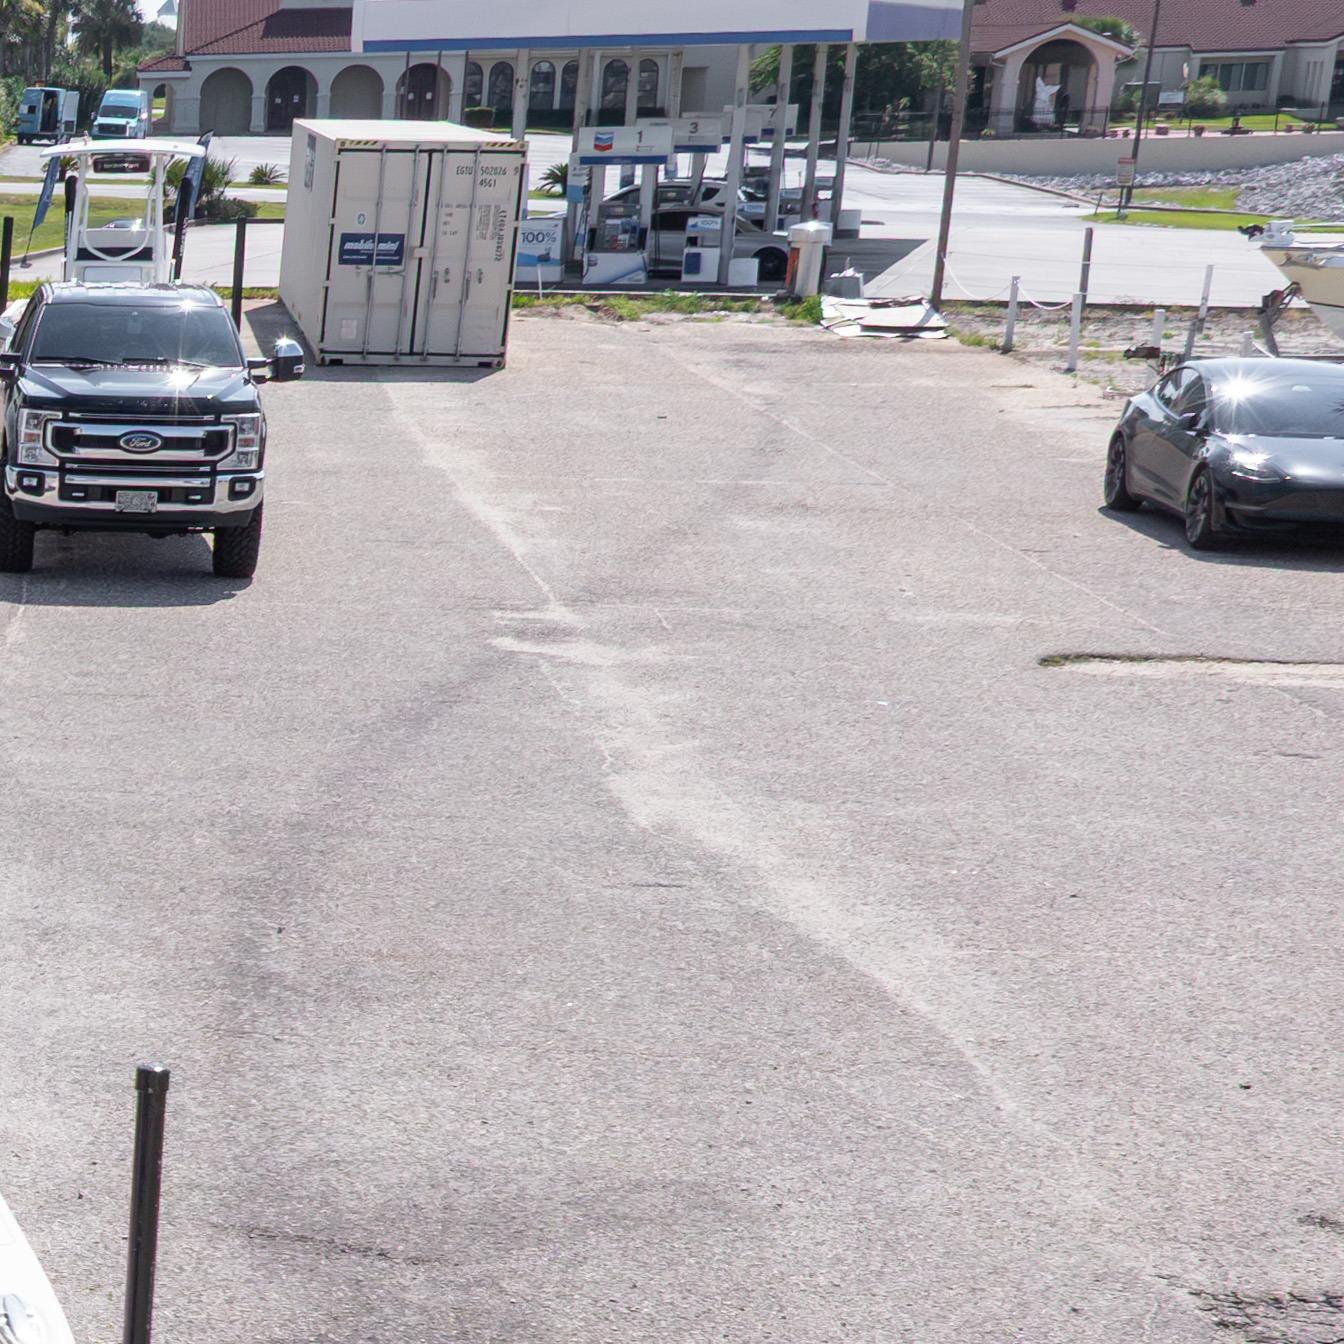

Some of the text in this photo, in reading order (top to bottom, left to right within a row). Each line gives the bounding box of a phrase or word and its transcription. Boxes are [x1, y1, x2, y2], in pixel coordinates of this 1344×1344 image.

[689, 122, 699, 134] 3
[637, 130, 644, 143] 1
[521, 231, 557, 243] 100%
[129, 437, 152, 448] Ford
